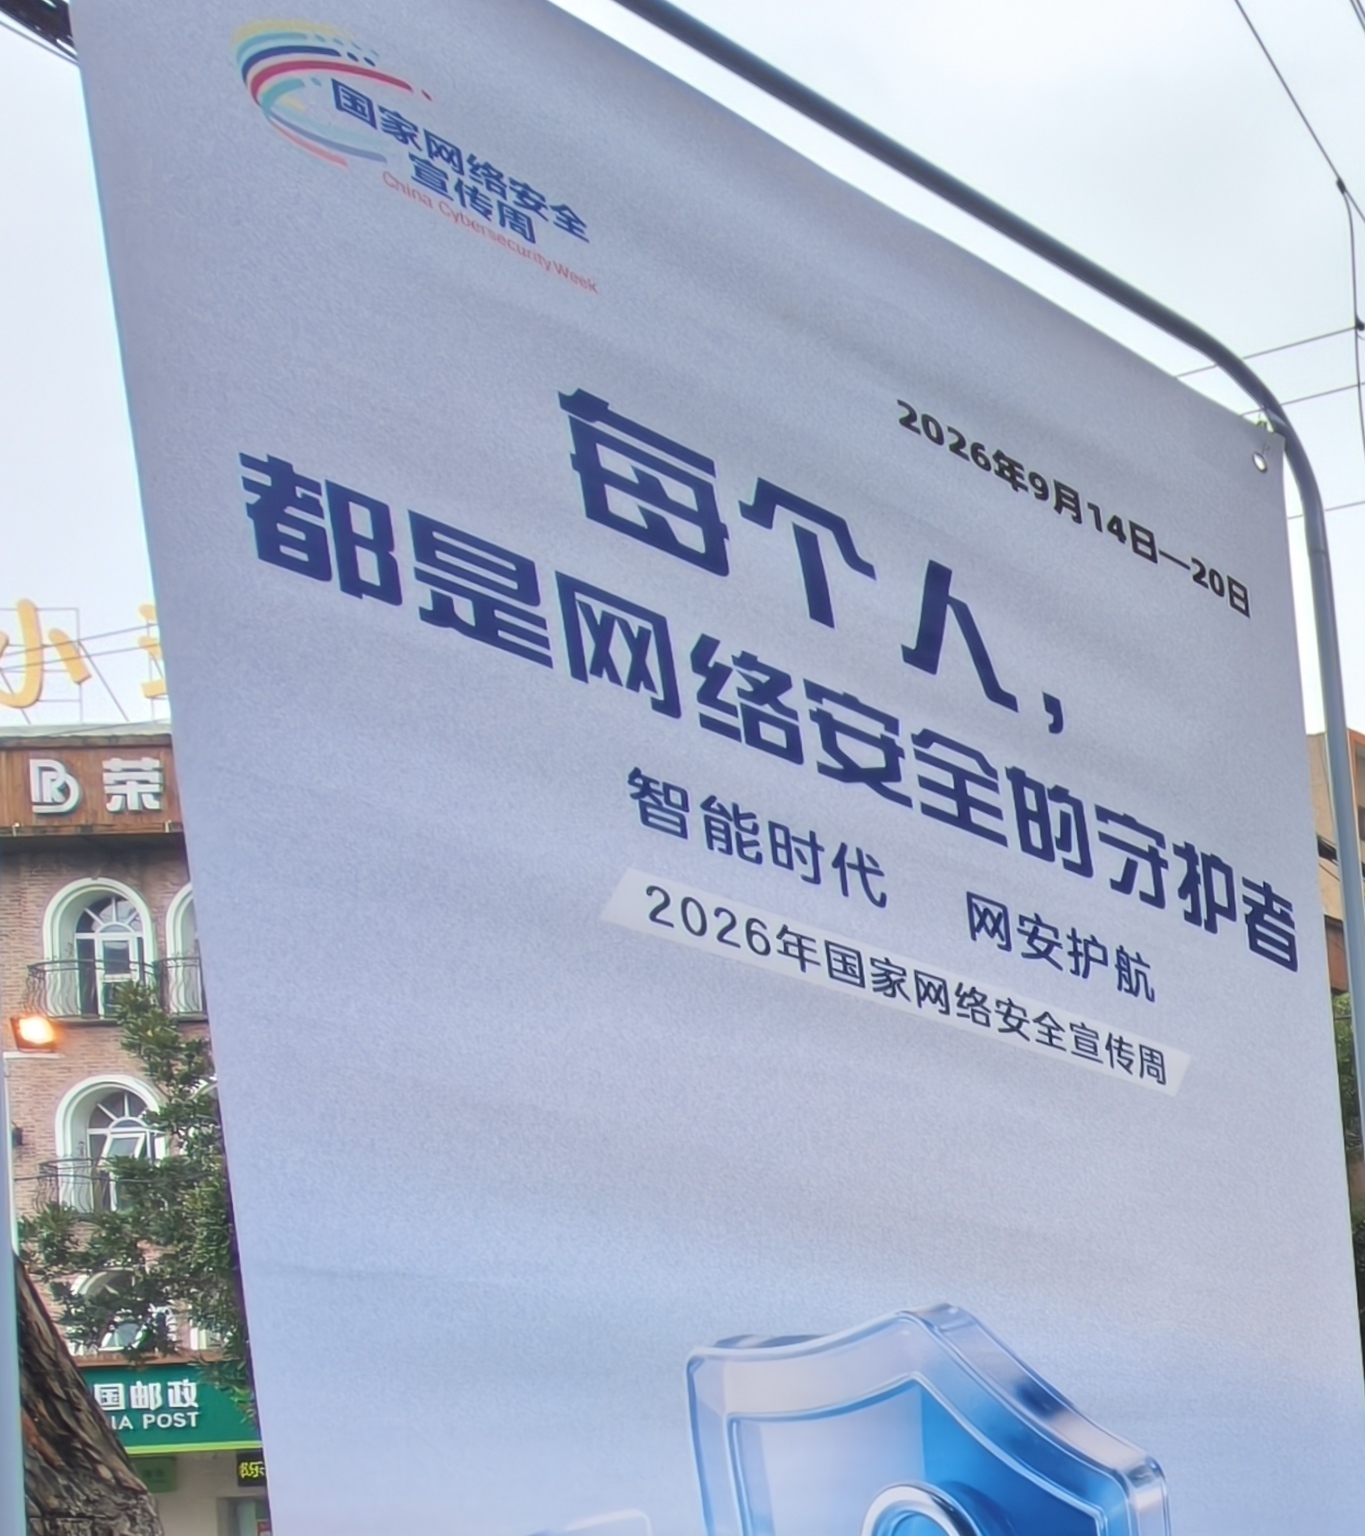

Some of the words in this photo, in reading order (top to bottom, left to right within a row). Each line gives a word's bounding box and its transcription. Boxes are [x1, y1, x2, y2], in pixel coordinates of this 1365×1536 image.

[331, 78, 590, 243] 国家网络安全
[382, 171, 433, 209] China
[438, 200, 552, 272] Cybersecurity
[552, 259, 599, 294] Week
[408, 152, 536, 244] 宣传周
[239, 451, 1299, 972] 都是网络安全的守护者
[102, 758, 163, 813] 荣
[627, 767, 888, 908] 智能时代
[966, 891, 1156, 1002] 网安护航
[644, 884, 1168, 1086] 2026年国家网络安全宣传周
[143, 1412, 200, 1430] POST
